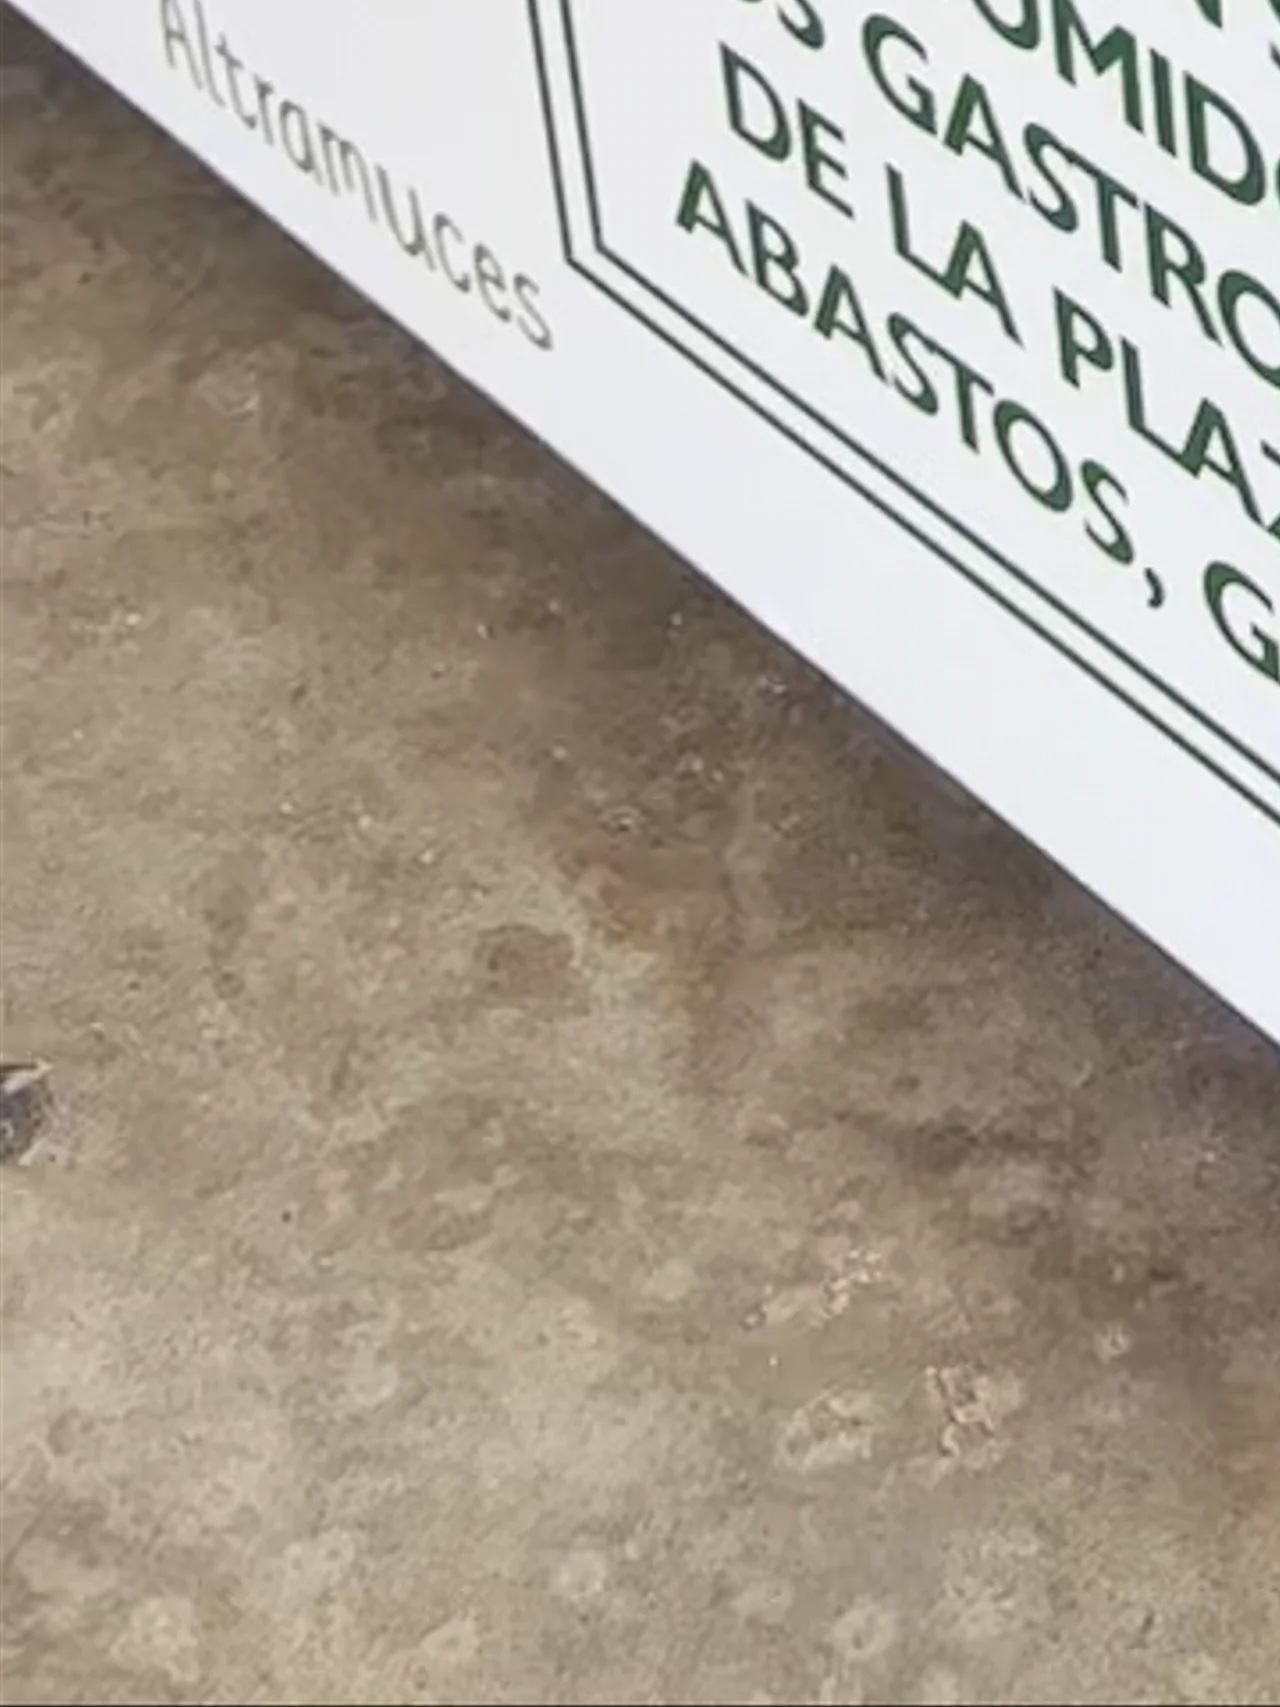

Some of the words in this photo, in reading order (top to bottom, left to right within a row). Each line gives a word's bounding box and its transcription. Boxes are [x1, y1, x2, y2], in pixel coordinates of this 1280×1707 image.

[673, 157, 1167, 612] ABASTOS,
[717, 40, 856, 222] DE
[883, 161, 1025, 349] LA
